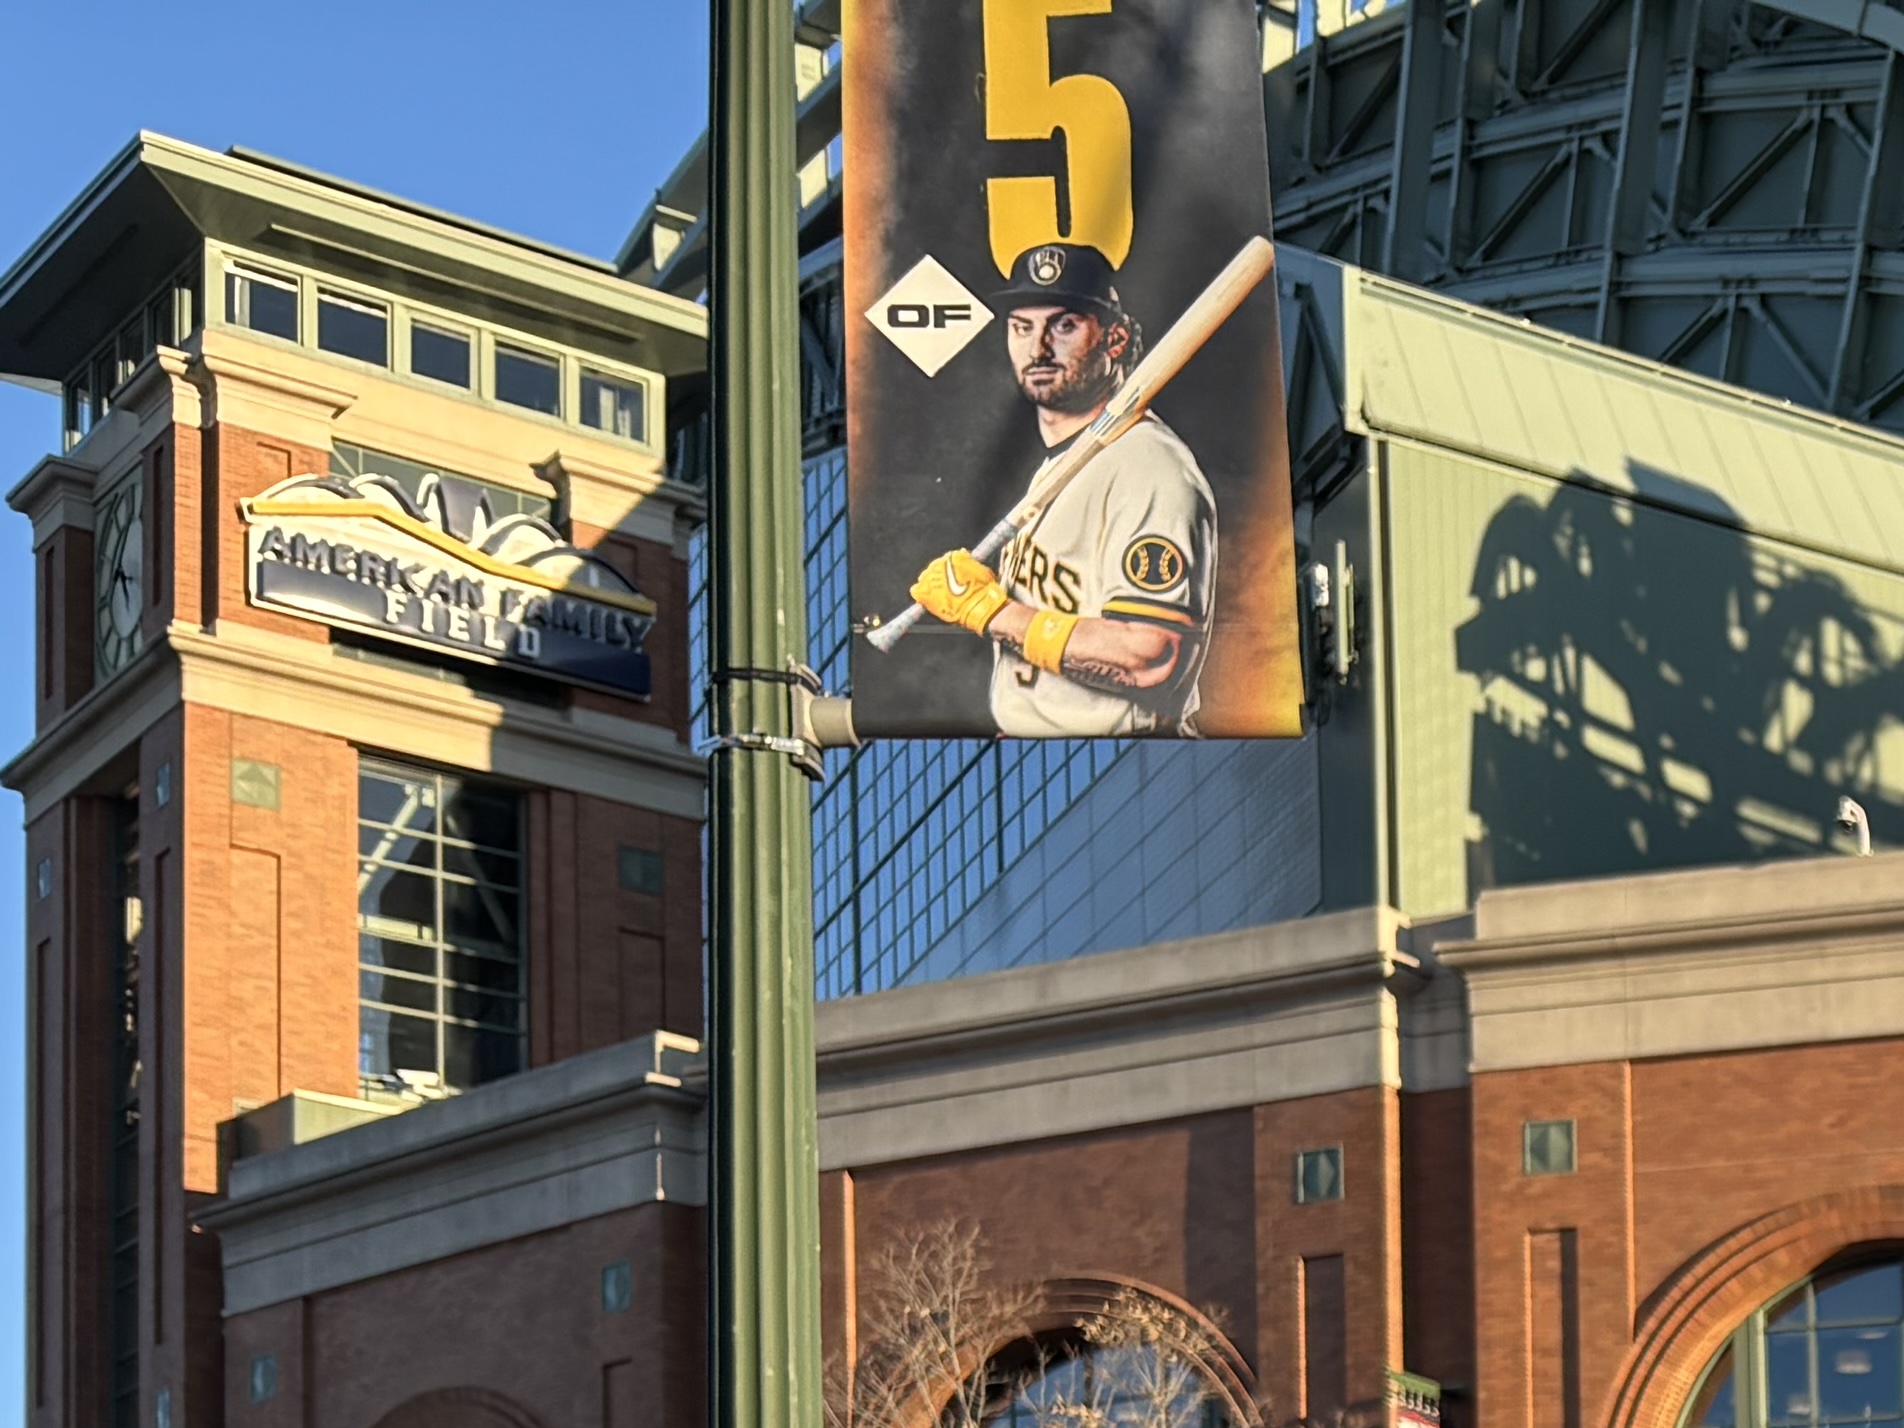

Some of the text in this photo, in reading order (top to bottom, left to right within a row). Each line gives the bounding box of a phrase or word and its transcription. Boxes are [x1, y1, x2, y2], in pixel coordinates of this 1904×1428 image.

[982, 0, 1134, 281] 5
[885, 303, 973, 330] OF
[258, 525, 653, 655] AMERICAN FAMILY
[385, 590, 542, 660] FIELD
